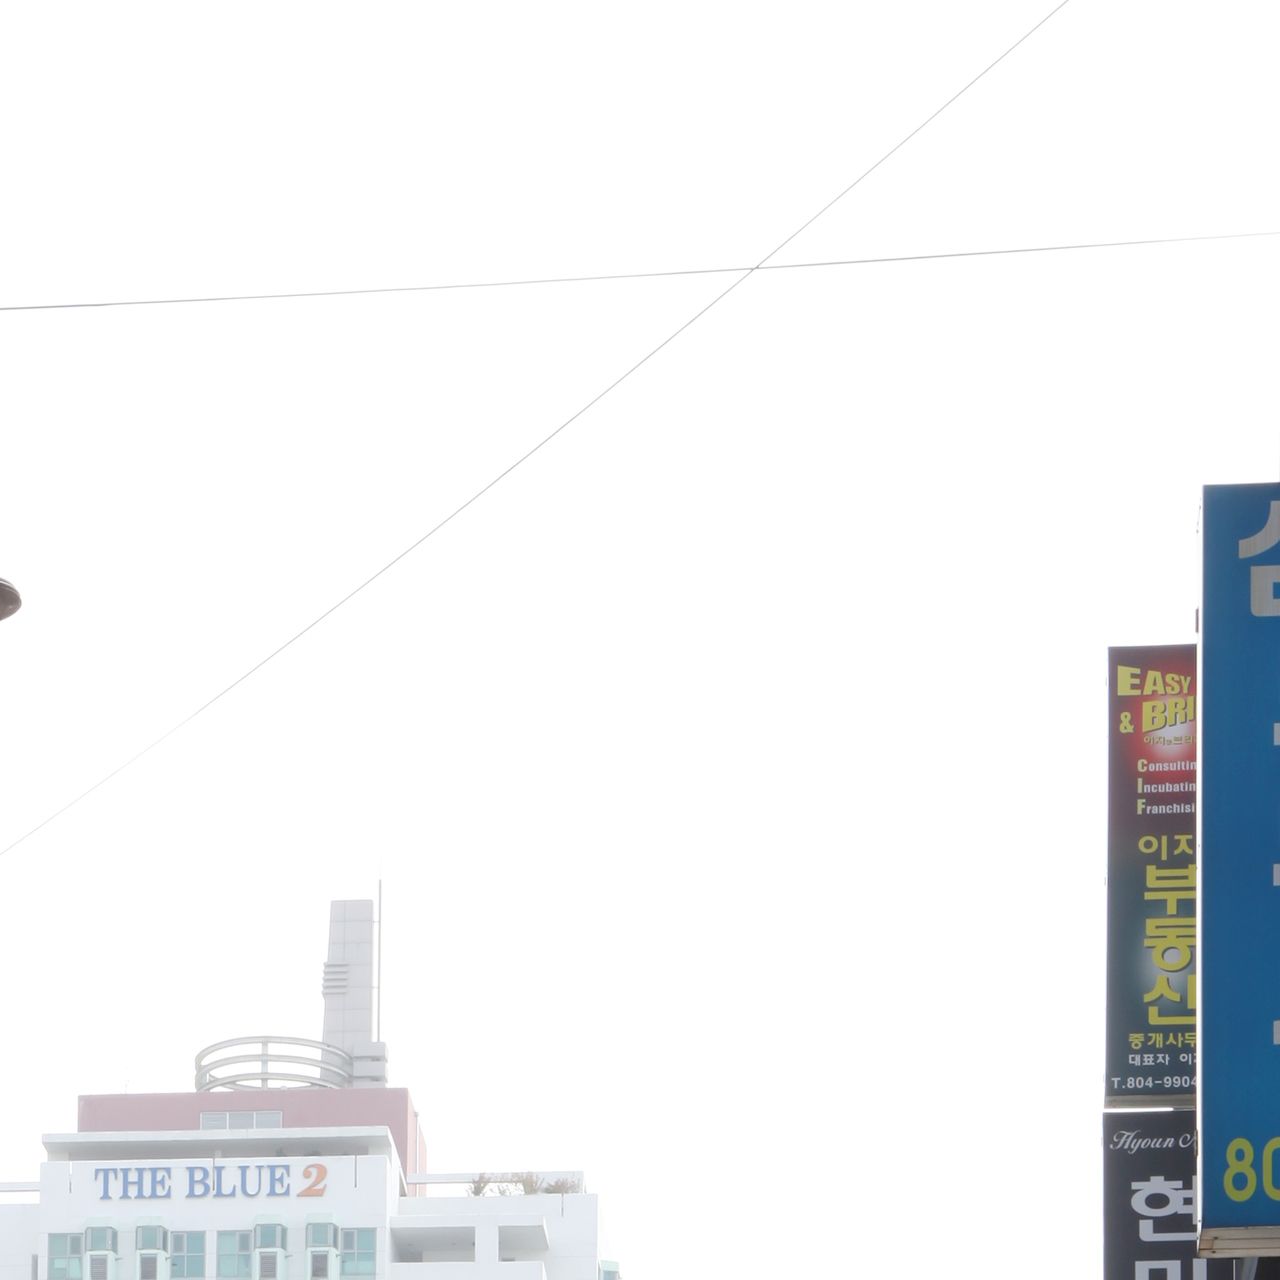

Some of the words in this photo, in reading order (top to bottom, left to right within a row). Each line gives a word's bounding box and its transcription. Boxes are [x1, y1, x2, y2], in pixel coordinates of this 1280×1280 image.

[1117, 665, 1192, 697] EASY
[1143, 863, 1197, 1026] 부동산
[95, 1166, 171, 1200] THE
[186, 1164, 291, 1199] BLUE
[297, 1163, 328, 1198] 2
